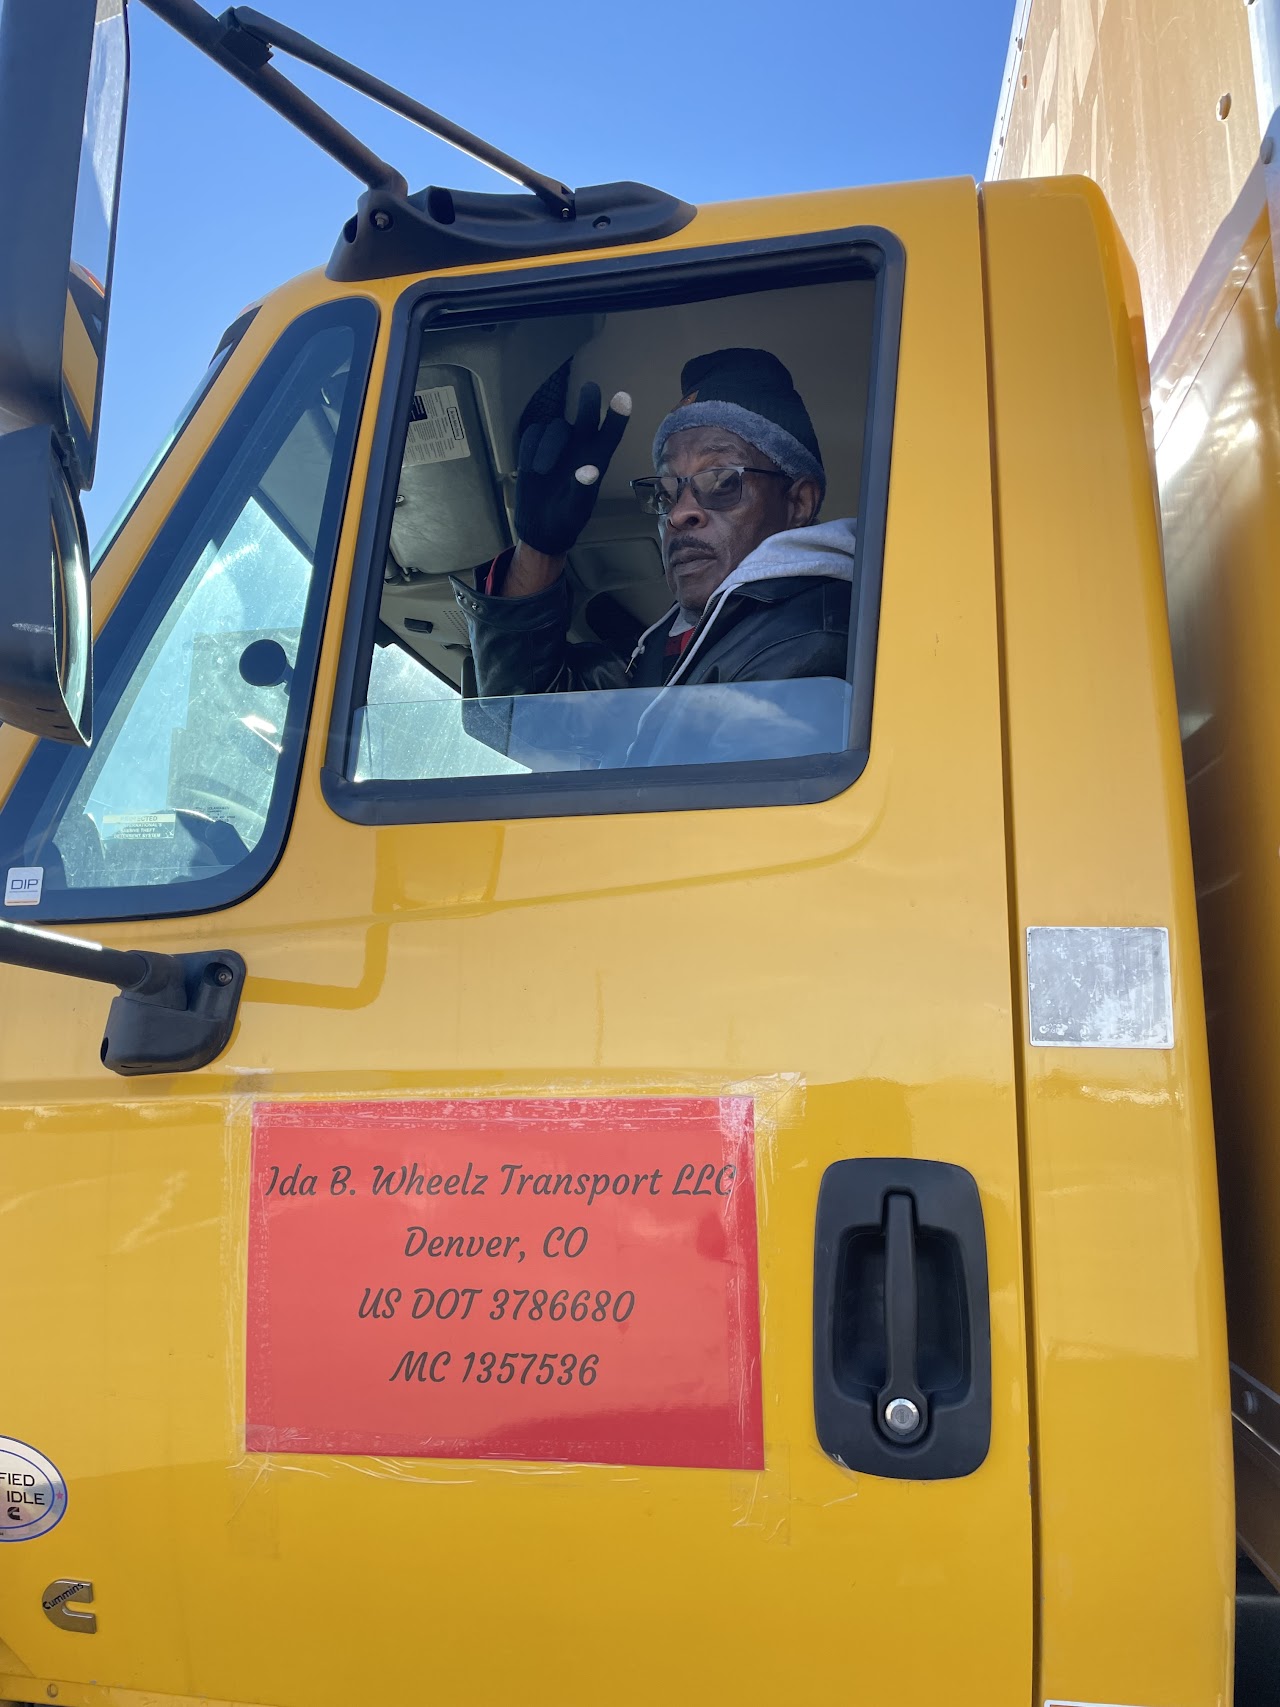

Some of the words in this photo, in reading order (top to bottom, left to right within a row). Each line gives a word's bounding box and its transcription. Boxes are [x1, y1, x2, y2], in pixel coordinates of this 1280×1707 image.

[11, 878, 39, 890] DIP
[265, 1163, 319, 1196] Ida
[329, 1165, 356, 1196] B.
[371, 1162, 490, 1196] Wheelz
[500, 1164, 663, 1206] Transport
[671, 1163, 738, 1196] LLC
[404, 1225, 527, 1264] Denver,
[542, 1226, 589, 1259] CO
[358, 1287, 403, 1319] US
[411, 1287, 484, 1320] DOT
[489, 1288, 635, 1323] 3786680
[388, 1350, 452, 1383] MC
[461, 1351, 600, 1387] 1357536
[7, 1490, 46, 1506] IDLE
[42, 1583, 84, 1610] Cummins
